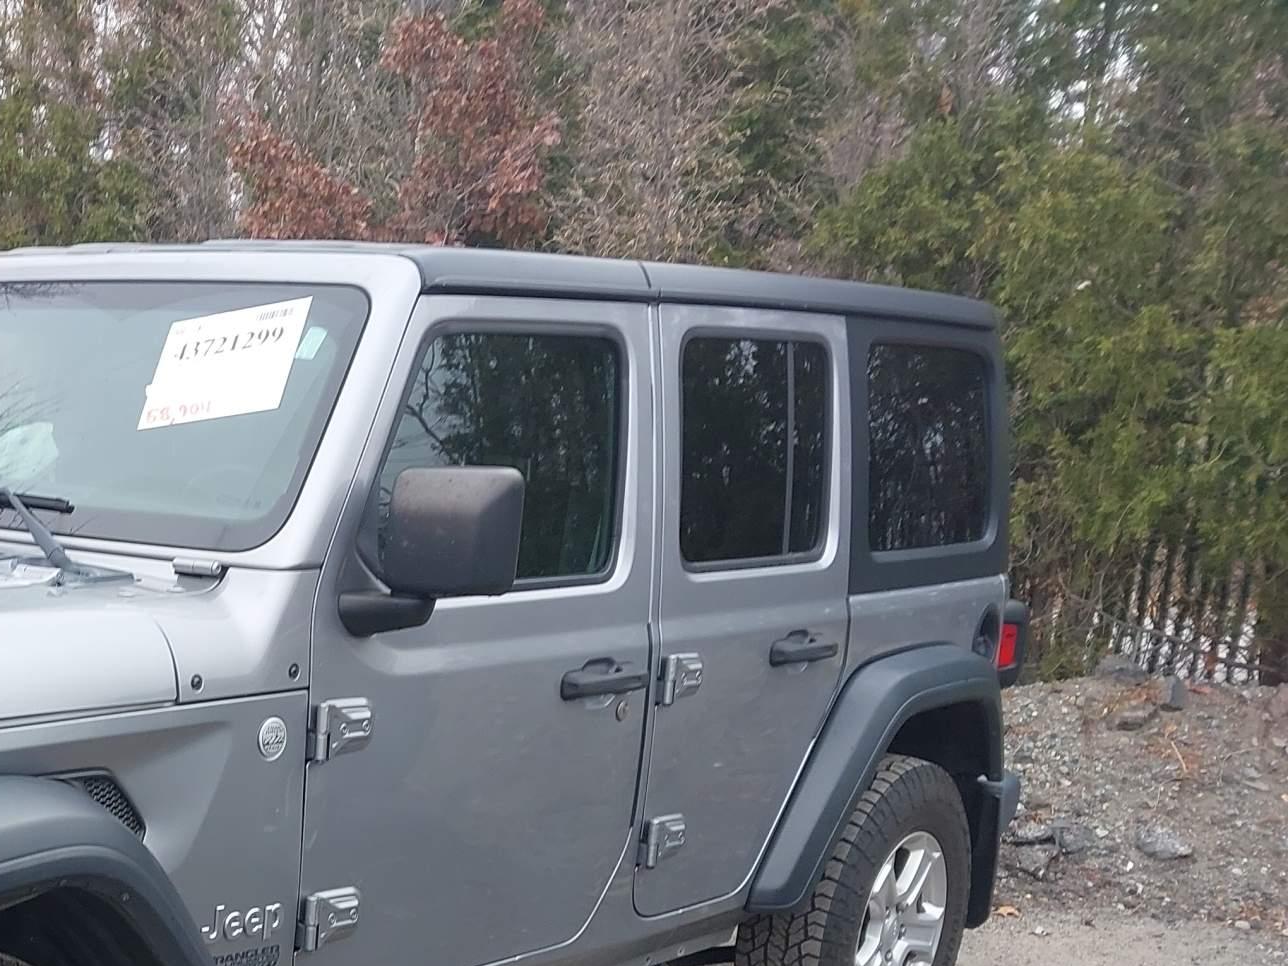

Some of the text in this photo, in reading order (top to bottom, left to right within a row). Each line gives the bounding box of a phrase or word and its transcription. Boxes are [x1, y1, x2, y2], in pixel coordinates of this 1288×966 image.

[174, 327, 284, 361] 43721299
[200, 903, 283, 942] Jeep
[213, 944, 280, 966] RANGLER
